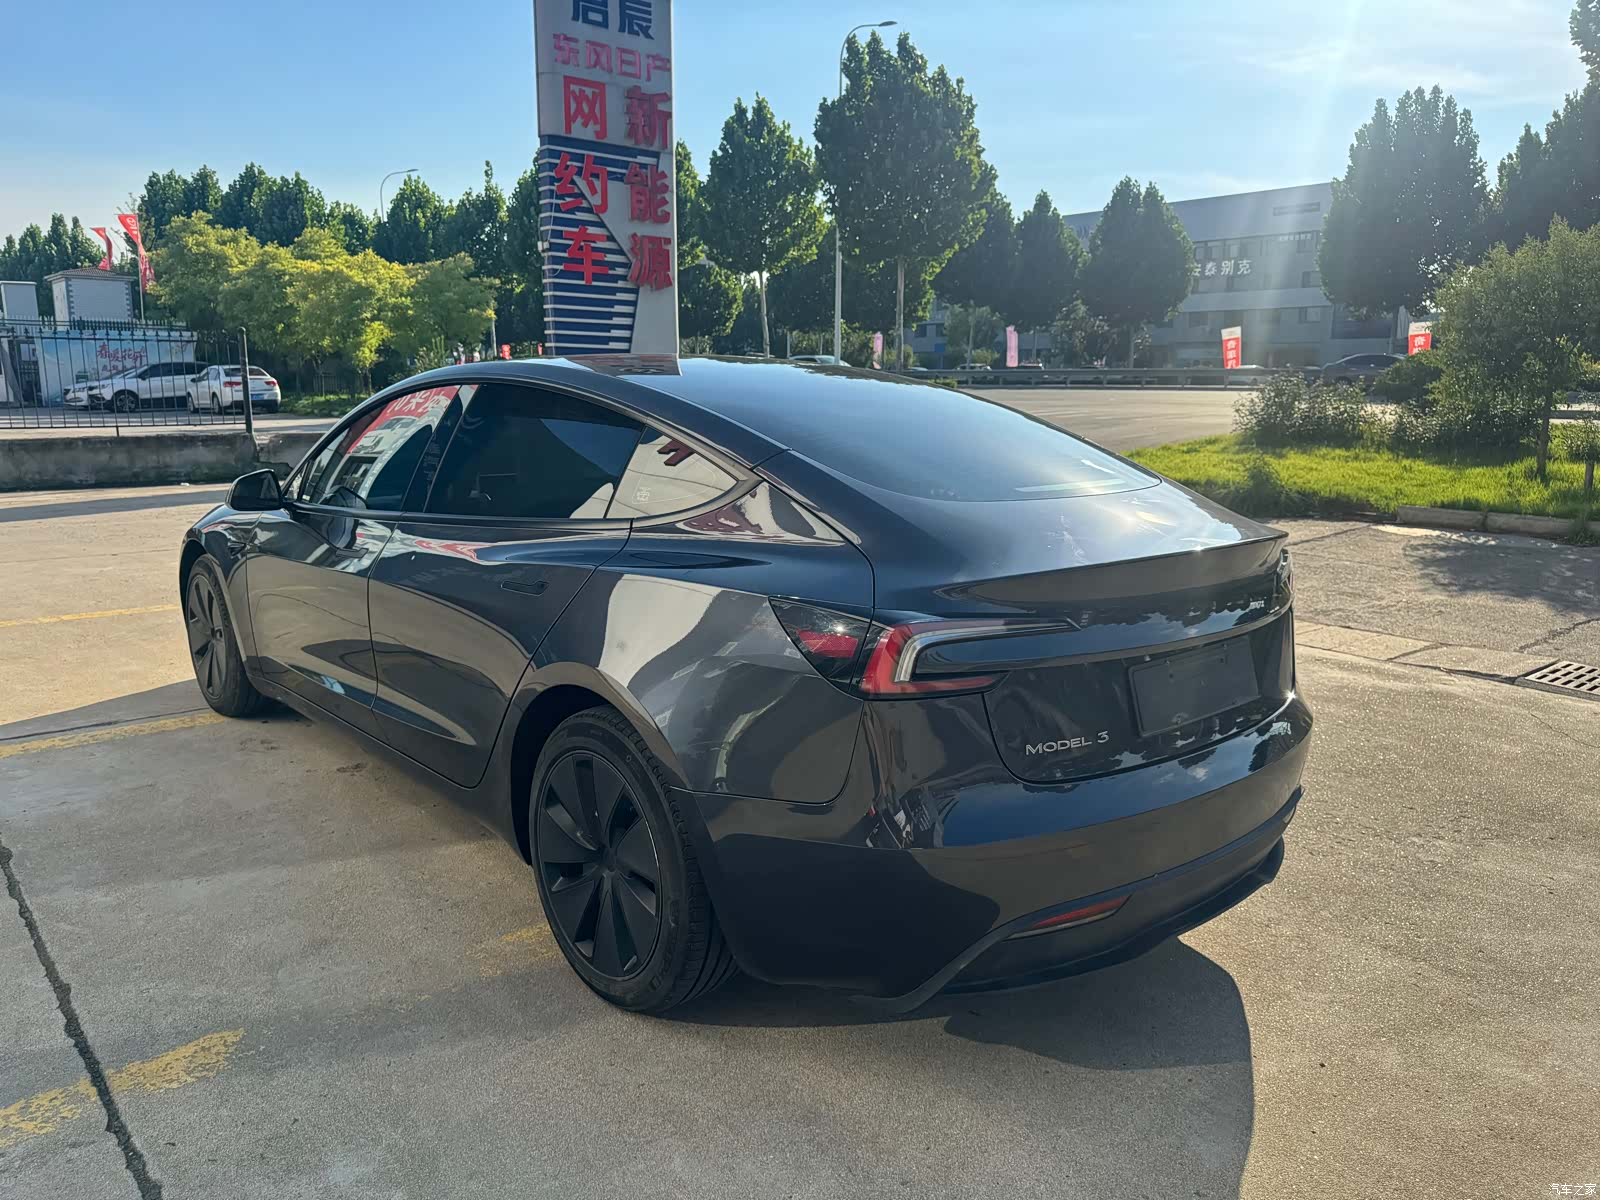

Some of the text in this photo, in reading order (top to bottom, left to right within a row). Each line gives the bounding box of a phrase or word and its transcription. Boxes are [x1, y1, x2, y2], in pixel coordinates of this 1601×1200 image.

[552, 32, 671, 82] 东风日产
[553, 75, 609, 285] 网约车
[624, 85, 673, 290] 新能源
[1025, 730, 1110, 756] MODEL 3
